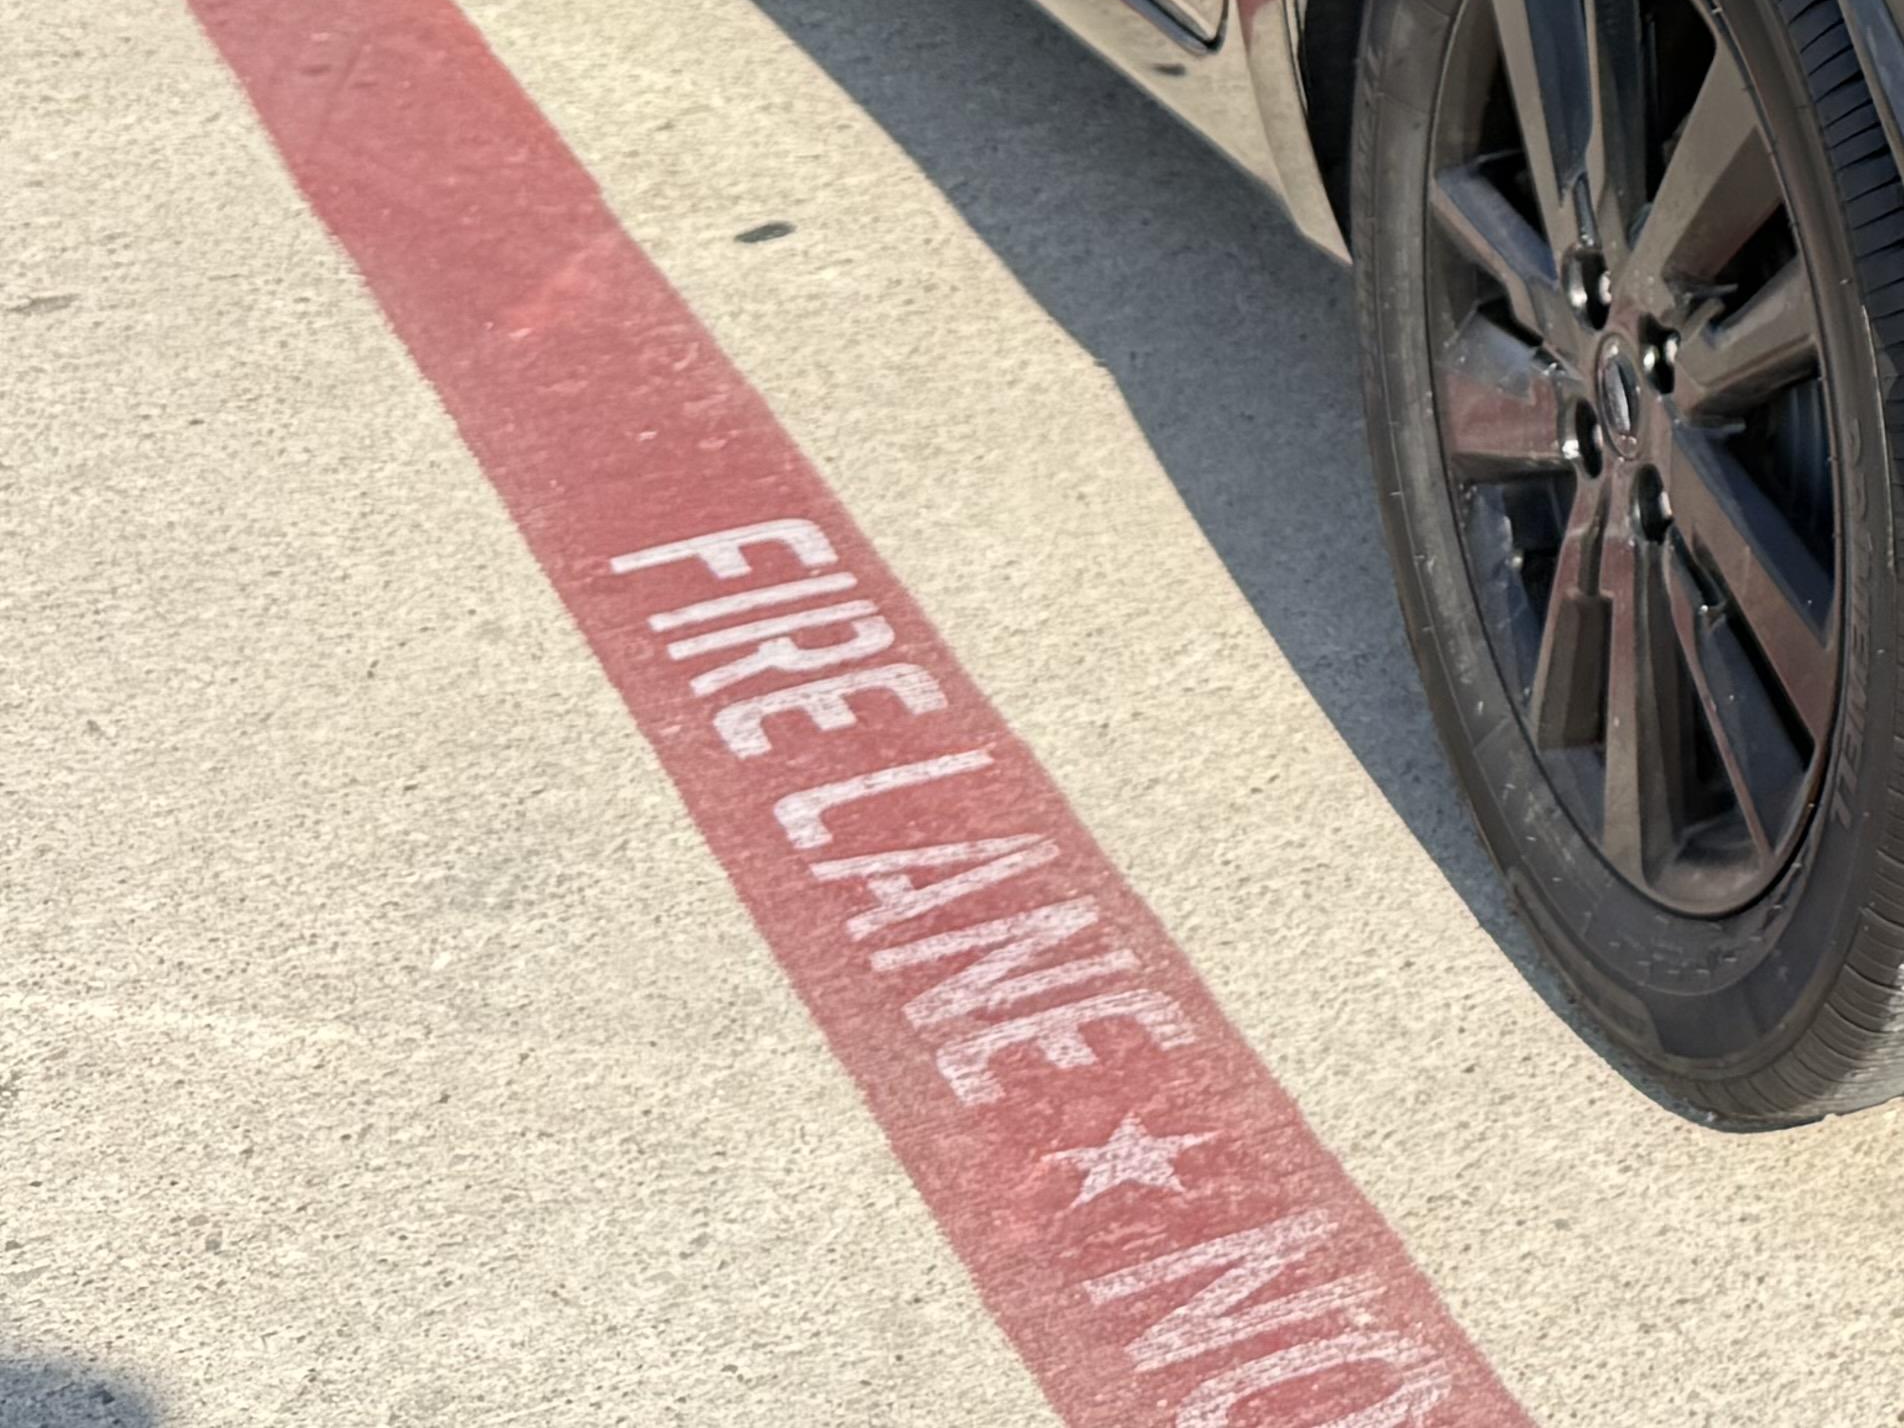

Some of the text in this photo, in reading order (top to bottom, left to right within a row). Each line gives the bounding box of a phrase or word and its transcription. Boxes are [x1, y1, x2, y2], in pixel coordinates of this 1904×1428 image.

[610, 518, 1453, 1428] FIRE LANE NO
